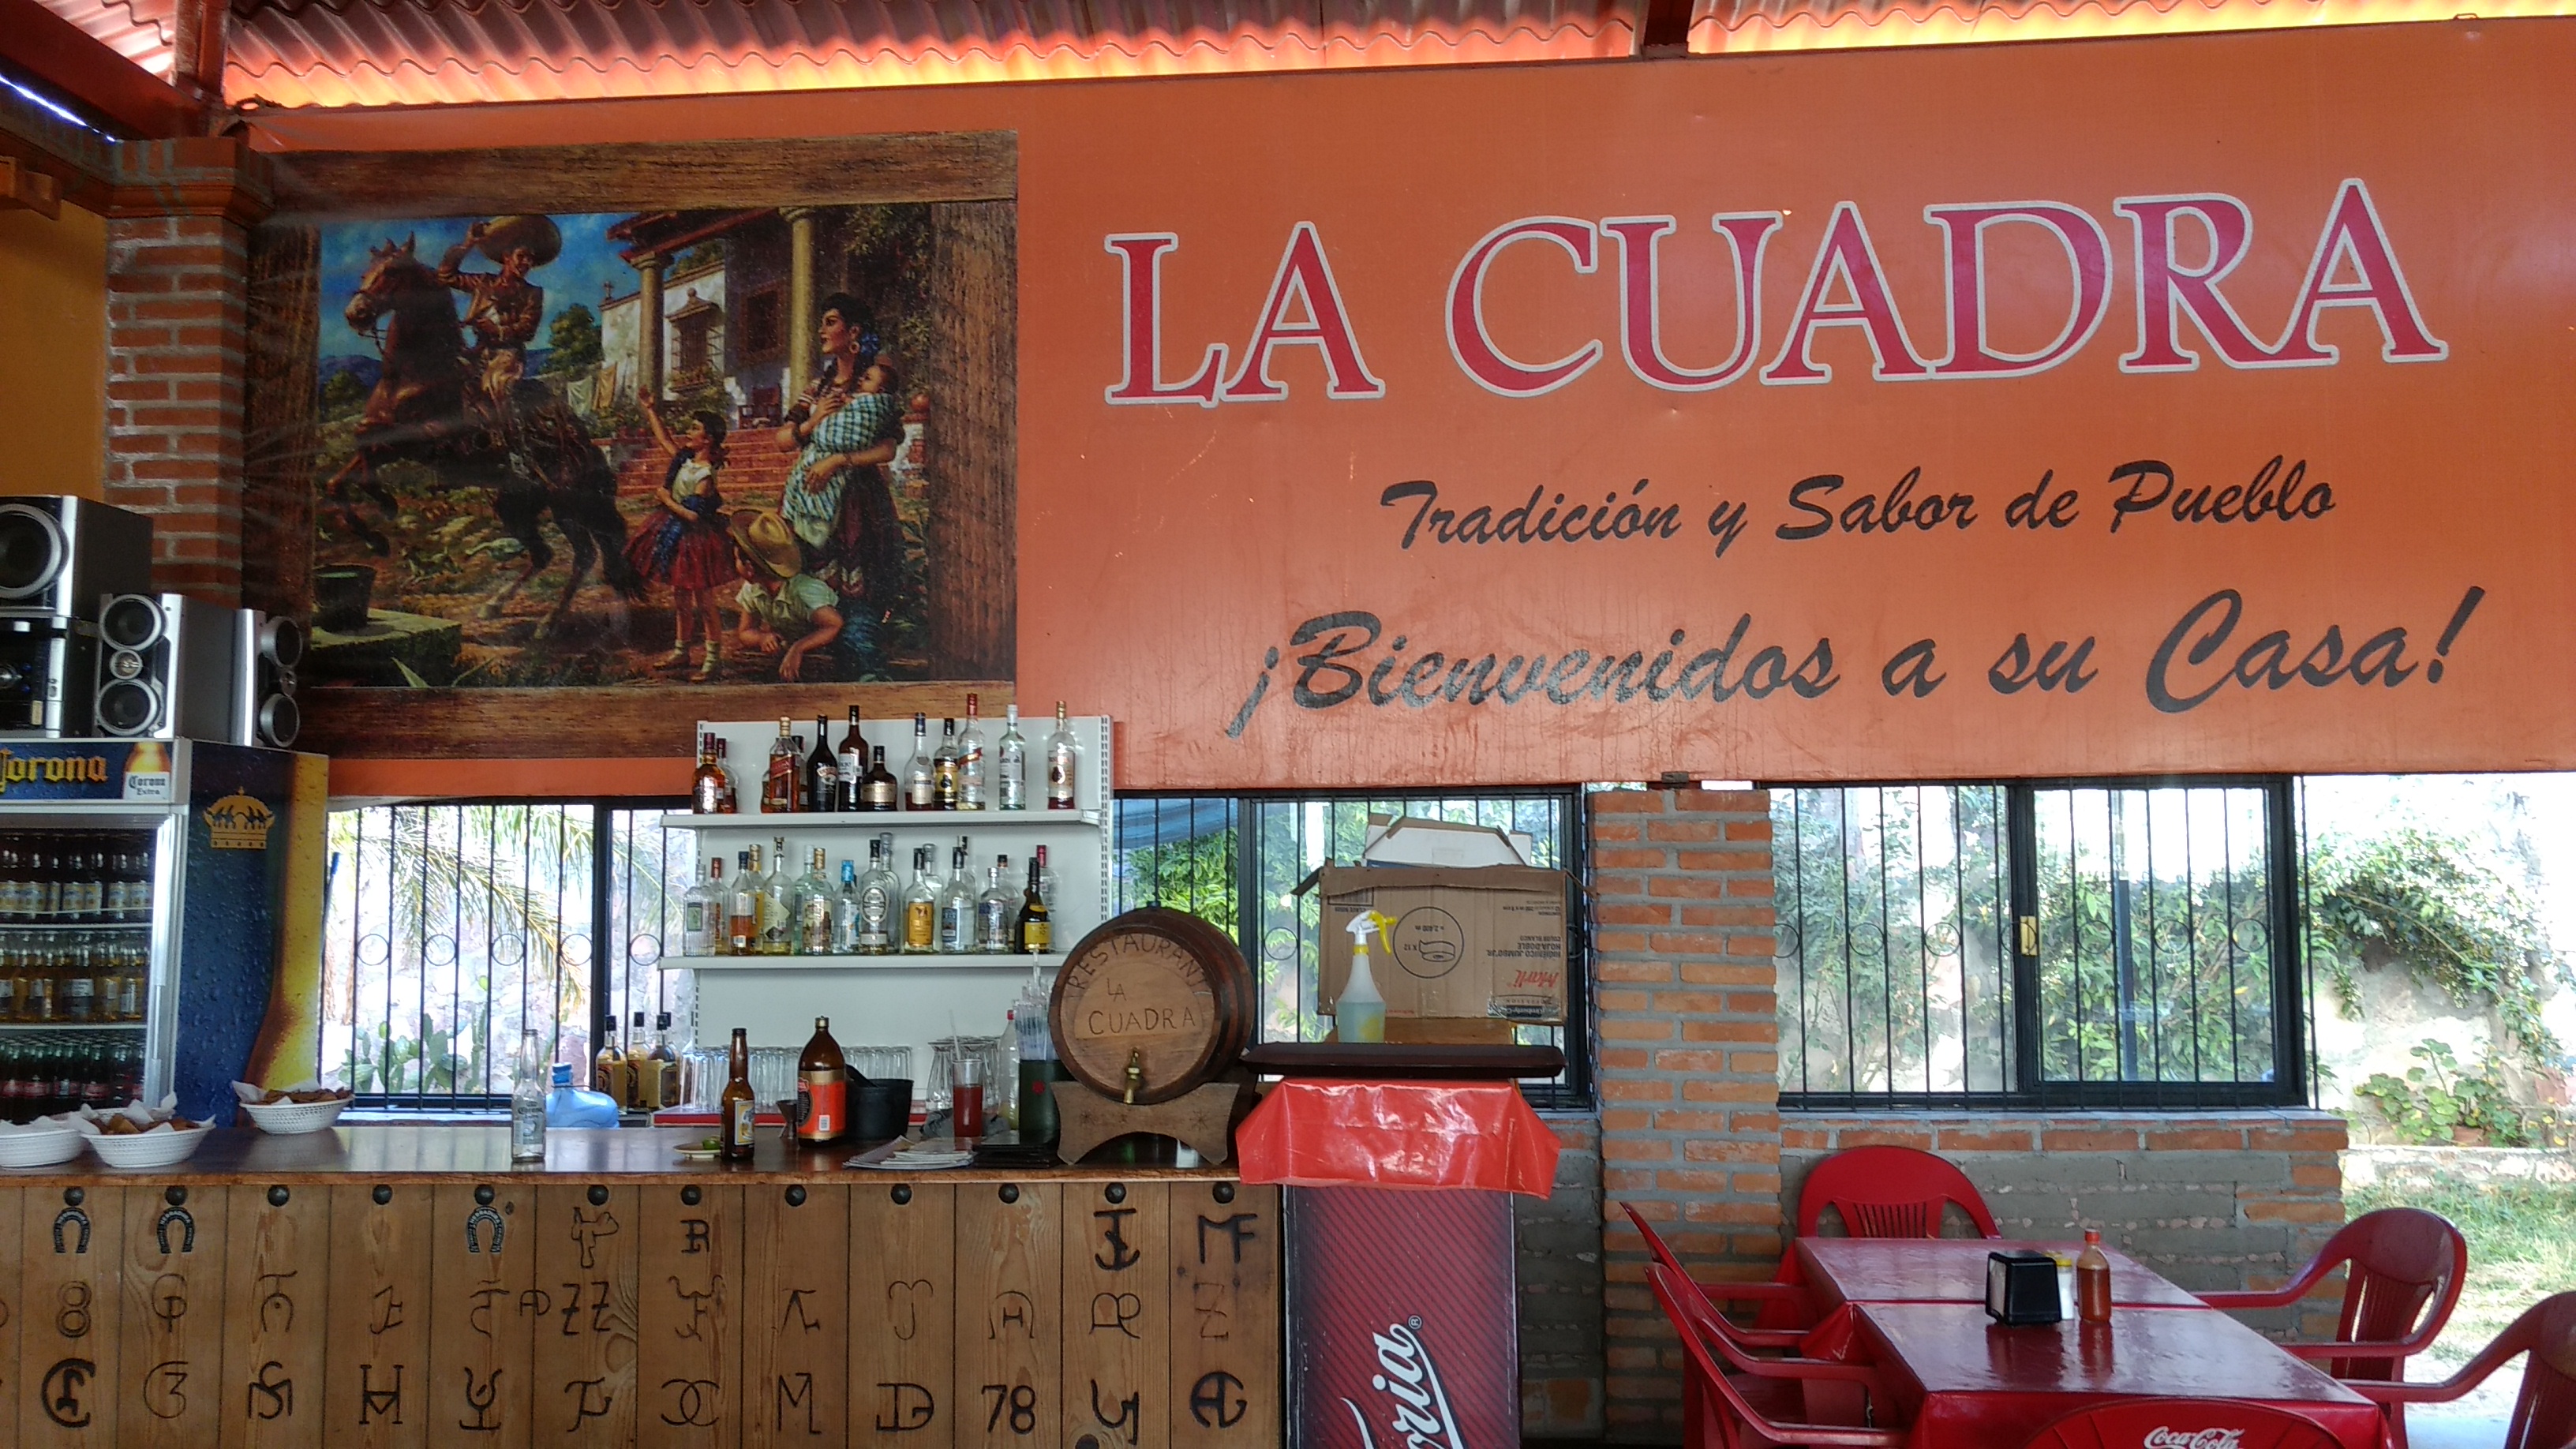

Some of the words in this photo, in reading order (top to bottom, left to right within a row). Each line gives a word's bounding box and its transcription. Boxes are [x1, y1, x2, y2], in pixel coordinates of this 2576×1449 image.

[1105, 221, 1386, 407] LA
[1445, 178, 2449, 398] CUADRA
[1380, 478, 1682, 549] Tradición
[1709, 497, 1747, 558] y
[1774, 464, 1978, 540] Sabor
[2005, 469, 2079, 530] de
[2108, 454, 2336, 534] Pueblo
[1224, 610, 1841, 739] ¡Bienvenidos
[1881, 637, 1946, 698] a
[1987, 632, 2099, 695] su
[2144, 585, 2485, 714] Casa!
[129, 775, 166, 788] Corona
[1066, 934, 1208, 990] RESTAURANT
[1106, 978, 1127, 1002] LA
[1088, 1006, 1196, 1035] CUADRA
[981, 1384, 1036, 1435] 78
